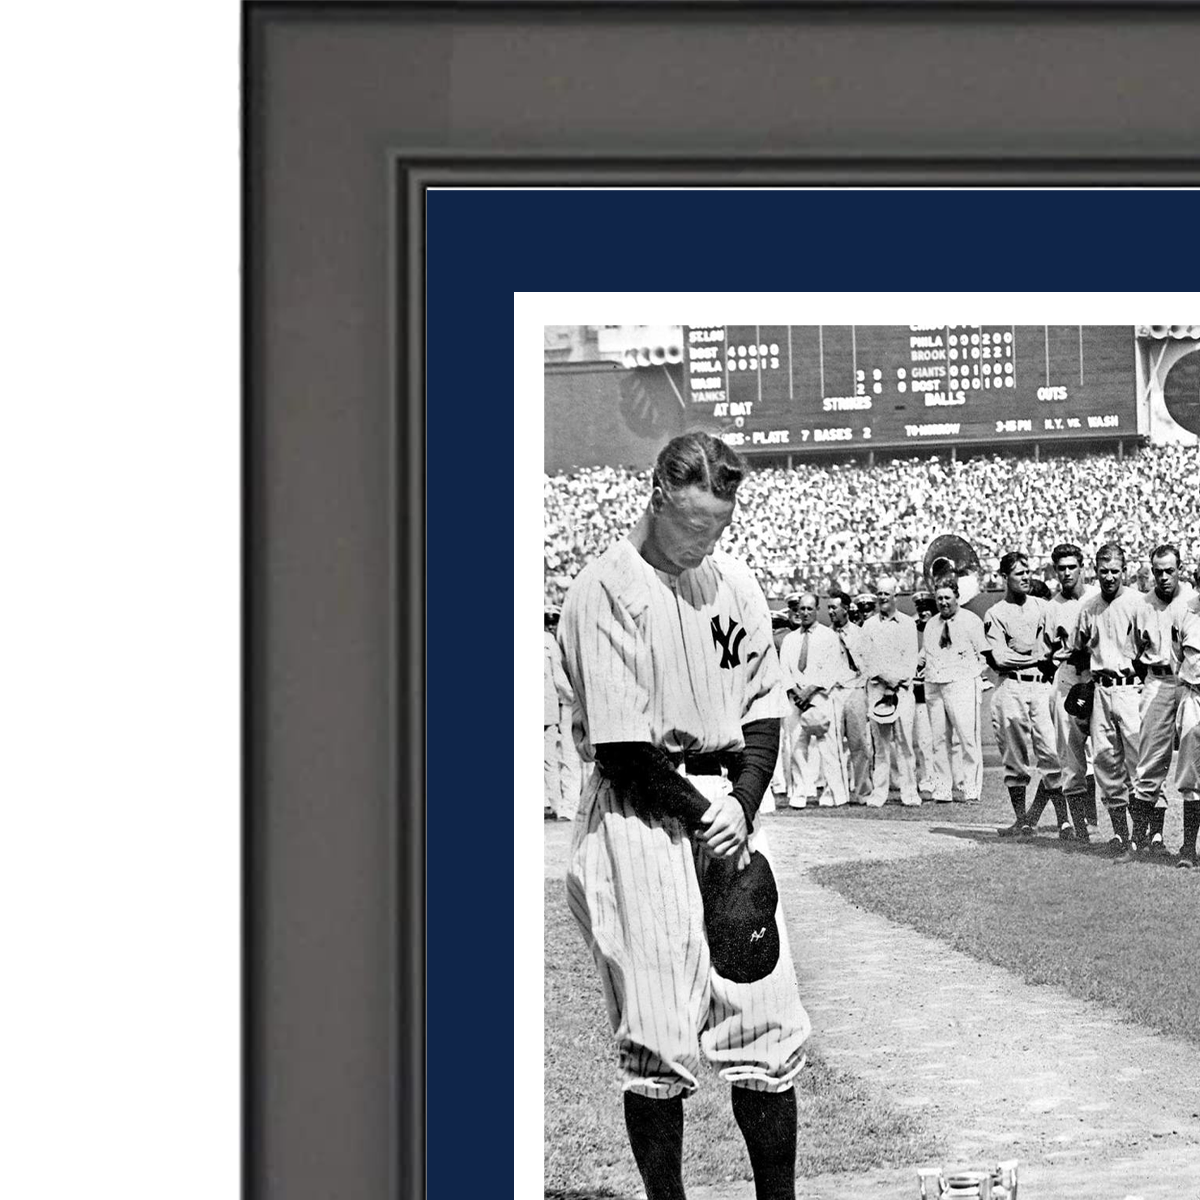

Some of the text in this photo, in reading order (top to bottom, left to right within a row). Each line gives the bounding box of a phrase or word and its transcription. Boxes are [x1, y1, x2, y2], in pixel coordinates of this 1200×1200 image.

[910, 335, 943, 348] PHILA
[911, 349, 946, 361] BROOK
[690, 361, 723, 374] PHILA
[912, 365, 947, 377] GIANTS
[912, 379, 941, 392] BOST
[691, 391, 725, 402] YANKS
[924, 391, 966, 407] BALLS
[1037, 386, 1068, 401] OUTS
[713, 402, 753, 416] AT BAT
[823, 396, 872, 411] STRIKES
[1087, 415, 1118, 428] WASH
[752, 430, 790, 444] PLATE
[801, 429, 810, 441] 7
[814, 428, 853, 441] BASES
[863, 427, 872, 439] 2
[710, 614, 747, 670] NY
